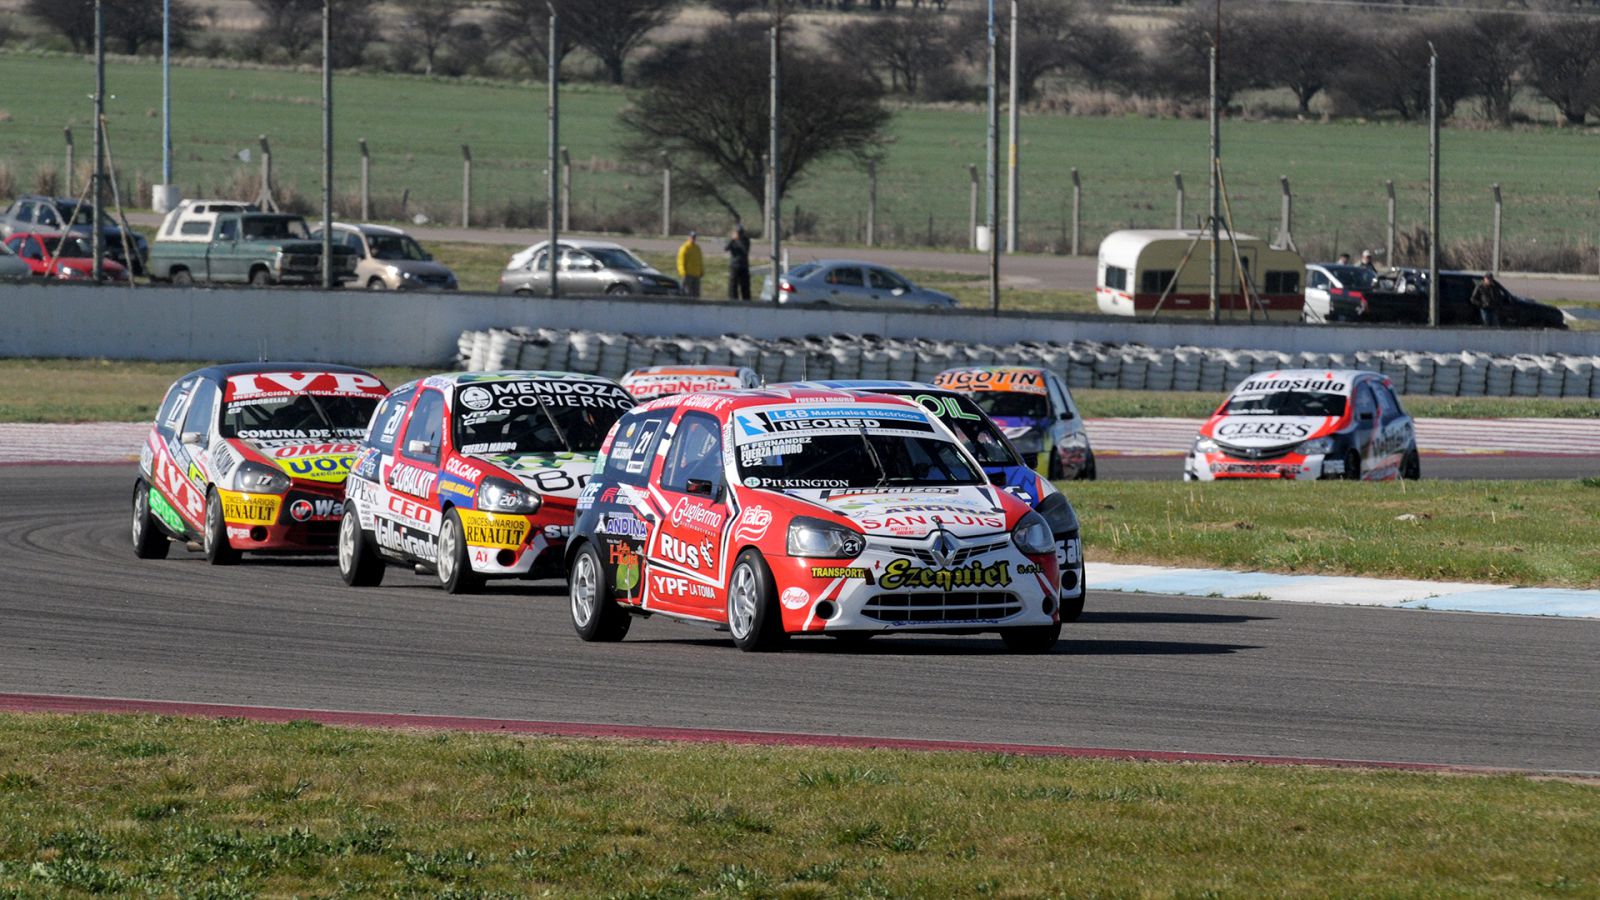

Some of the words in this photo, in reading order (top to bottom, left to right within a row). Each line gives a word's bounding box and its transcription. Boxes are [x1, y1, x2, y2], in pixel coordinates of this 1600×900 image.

[227, 371, 381, 395] IVP
[934, 371, 1037, 386] BIGOTIN
[1242, 378, 1346, 392] Autosiglo
[232, 391, 291, 400] INSPECCION
[348, 390, 385, 399] PUERTO
[492, 381, 629, 399] MENDOZA
[497, 395, 635, 411] GOBIERNO
[462, 409, 511, 419] VITAR
[774, 409, 809, 420] L&B
[811, 408, 866, 417] Materiales
[867, 409, 920, 420] Eléctricos
[463, 417, 487, 426] C2
[781, 419, 881, 431] NEORED
[237, 429, 307, 439] COMUNA
[308, 429, 331, 438] DE
[1218, 423, 1313, 437] CERES
[460, 443, 488, 453] FUERZA
[488, 442, 517, 452] MAURO
[634, 431, 654, 454] 21
[740, 443, 750, 451] M
[751, 437, 812, 449] FERNANDEZ
[740, 448, 771, 462] FUERZA
[772, 444, 803, 456] MAURO
[445, 457, 482, 483] COLCAR
[742, 458, 763, 468] C2
[156, 448, 204, 518] IVP
[256, 475, 274, 486] 17
[390, 462, 437, 499] GLOBALKIT
[760, 478, 849, 488] PILKINGTON
[581, 483, 603, 497] YPF
[225, 495, 276, 507] CONCESIONARIOS
[499, 495, 515, 507] 20
[224, 503, 280, 521] RENAULT
[671, 497, 722, 528] Gugliermo
[467, 516, 525, 530] CONCESIONARIOS
[607, 518, 648, 538] ANDINA
[861, 515, 927, 529] SAN
[935, 514, 1004, 529] LUIS
[466, 526, 525, 546] RENAULT
[661, 533, 700, 569] RUS
[845, 543, 860, 553] 21
[879, 558, 1012, 592] Ezequiel
[653, 575, 689, 597] YPF
[689, 584, 698, 596] LA
[698, 585, 716, 599] TOMA
